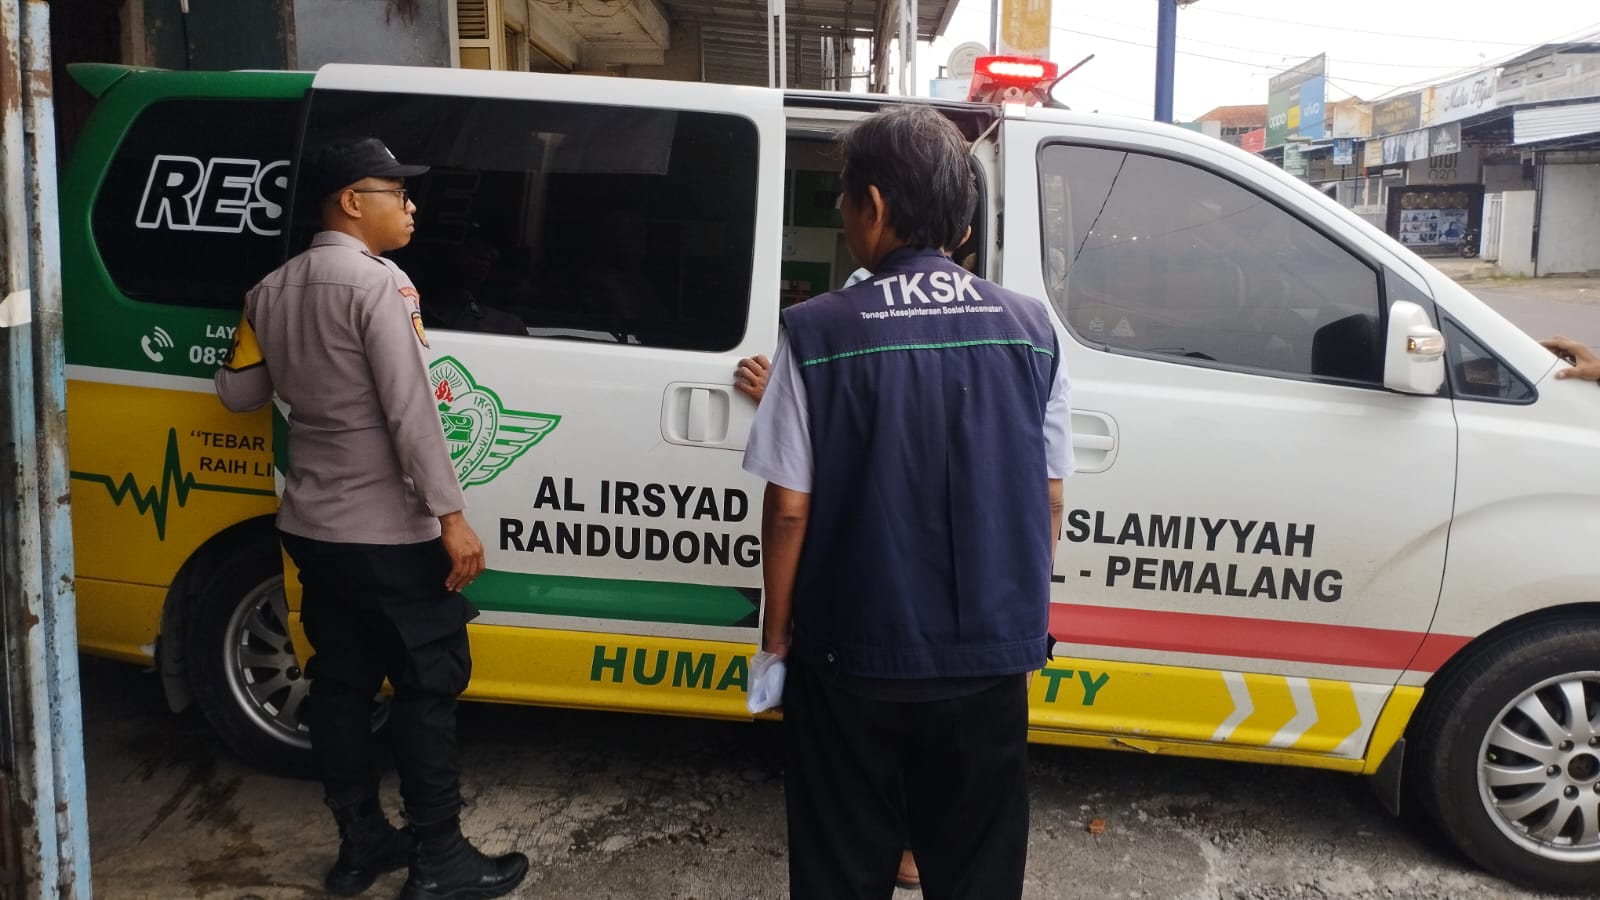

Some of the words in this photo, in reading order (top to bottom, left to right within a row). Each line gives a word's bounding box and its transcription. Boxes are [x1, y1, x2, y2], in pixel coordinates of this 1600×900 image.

[1303, 102, 1320, 117] vivo
[1269, 112, 1287, 131] oppo
[874, 271, 983, 306] TKSK
[861, 311, 889, 319] Tenaga
[889, 307, 942, 318] Kesejahteraan
[942, 305, 965, 315] Sosial
[965, 304, 1004, 313] Kecamatan
[206, 324, 237, 340] LAY
[200, 456, 247, 475] RAIH
[254, 462, 274, 478] LI
[533, 476, 585, 512] AL
[600, 480, 748, 522] IRSYAD
[1058, 509, 1316, 557] SLAMIYYAH
[499, 517, 761, 568] RANDUDONG
[1105, 555, 1343, 602] PEMALANG
[1040, 667, 1110, 706] TY
